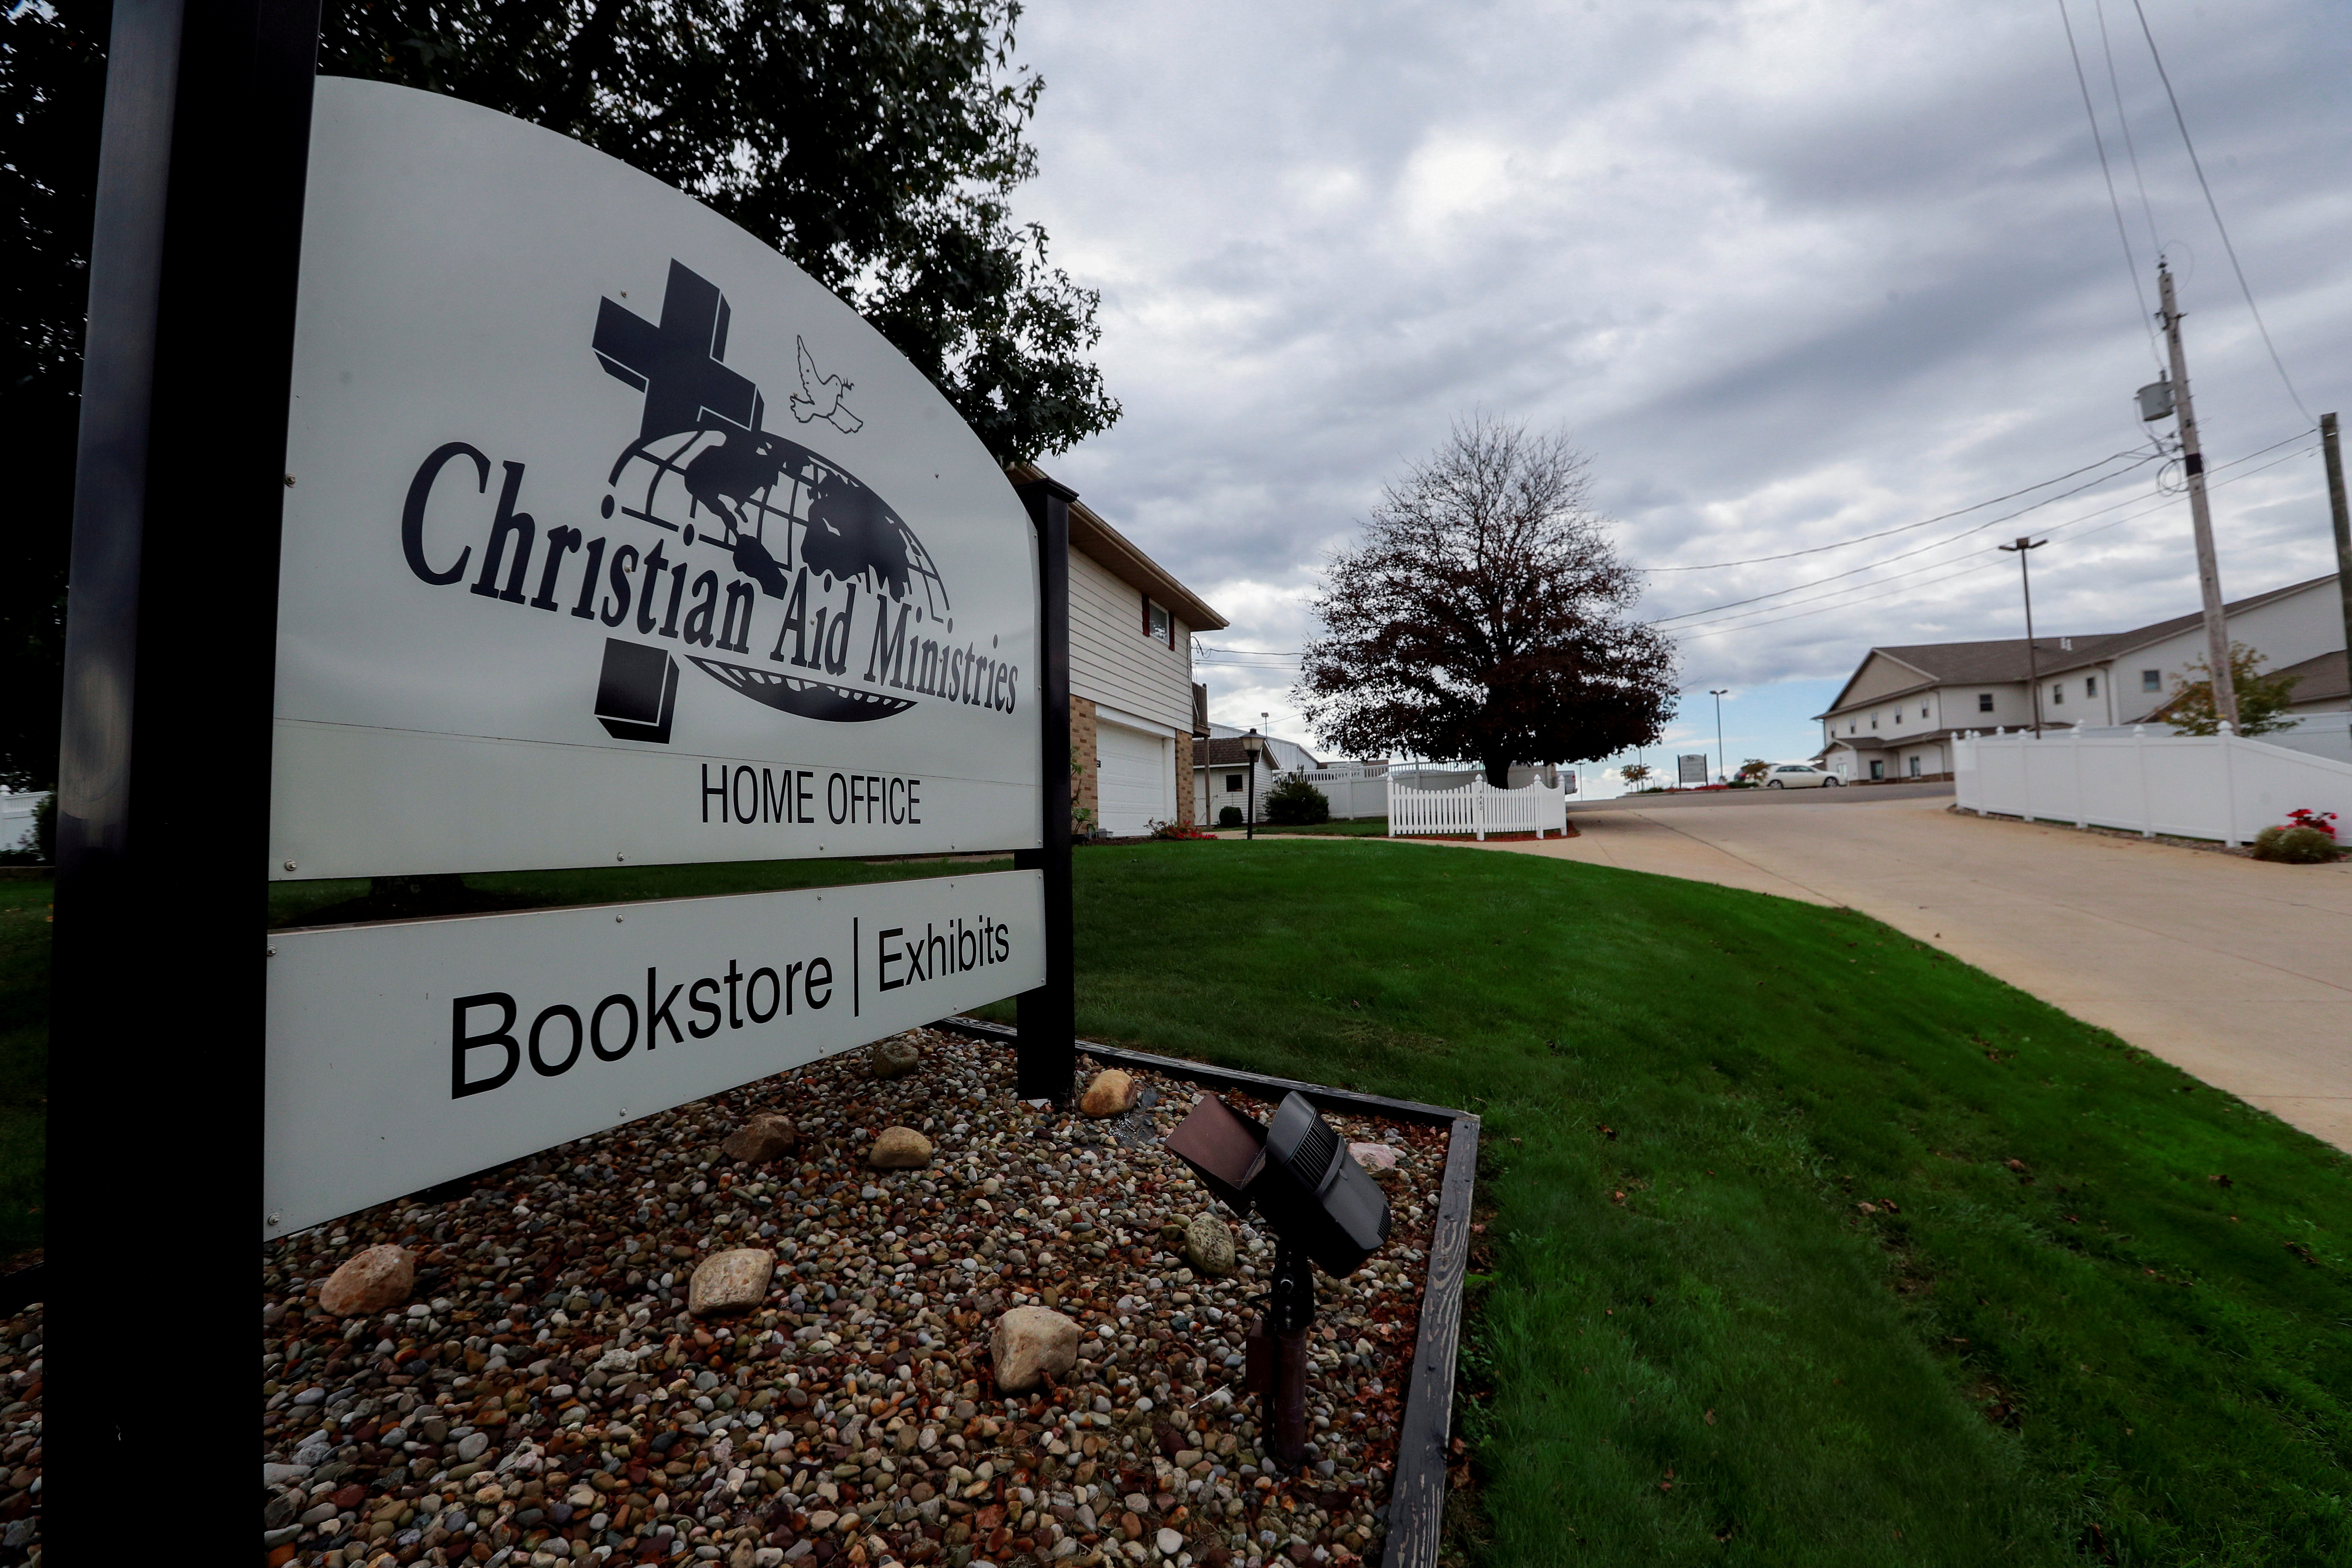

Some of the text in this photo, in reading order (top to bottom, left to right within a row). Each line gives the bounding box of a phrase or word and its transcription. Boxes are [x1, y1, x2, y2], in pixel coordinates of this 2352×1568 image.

[401, 441, 1018, 714] Christian Aid Ministries
[702, 763, 921, 824] HOME OFFICE
[452, 916, 1009, 1100] Bookstore Exhibits
